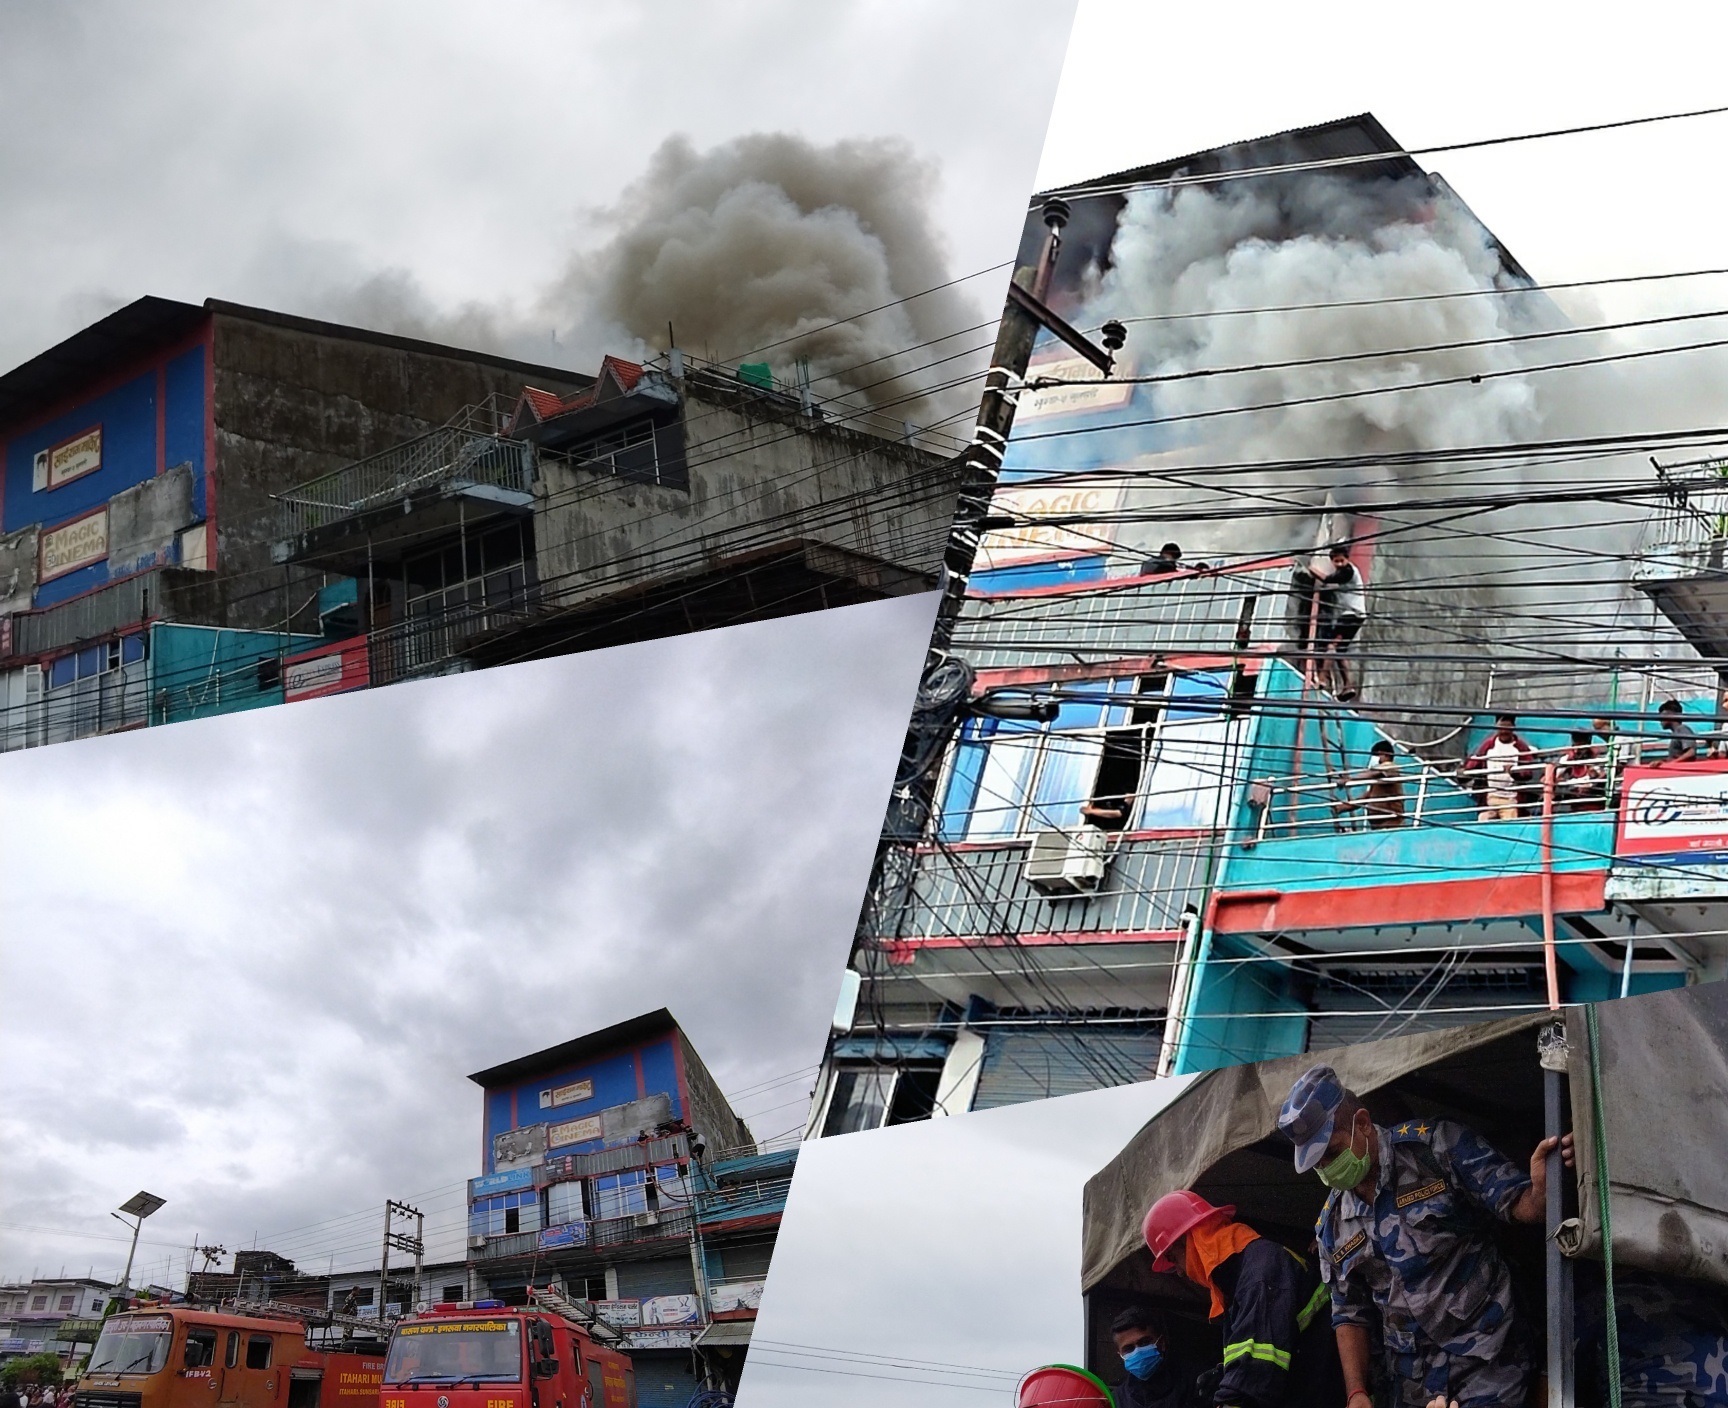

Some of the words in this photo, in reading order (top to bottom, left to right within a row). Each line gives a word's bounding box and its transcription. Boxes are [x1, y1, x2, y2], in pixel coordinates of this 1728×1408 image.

[55, 521, 99, 550] MAGIC
[45, 536, 105, 571] CINEMA
[551, 1127, 600, 1145] CINEMA
[560, 1120, 595, 1136] MAGIC
[463, 1320, 507, 1332] नगरपालिका
[362, 1362, 376, 1370] FIRE
[340, 1373, 370, 1384] ITAHARI
